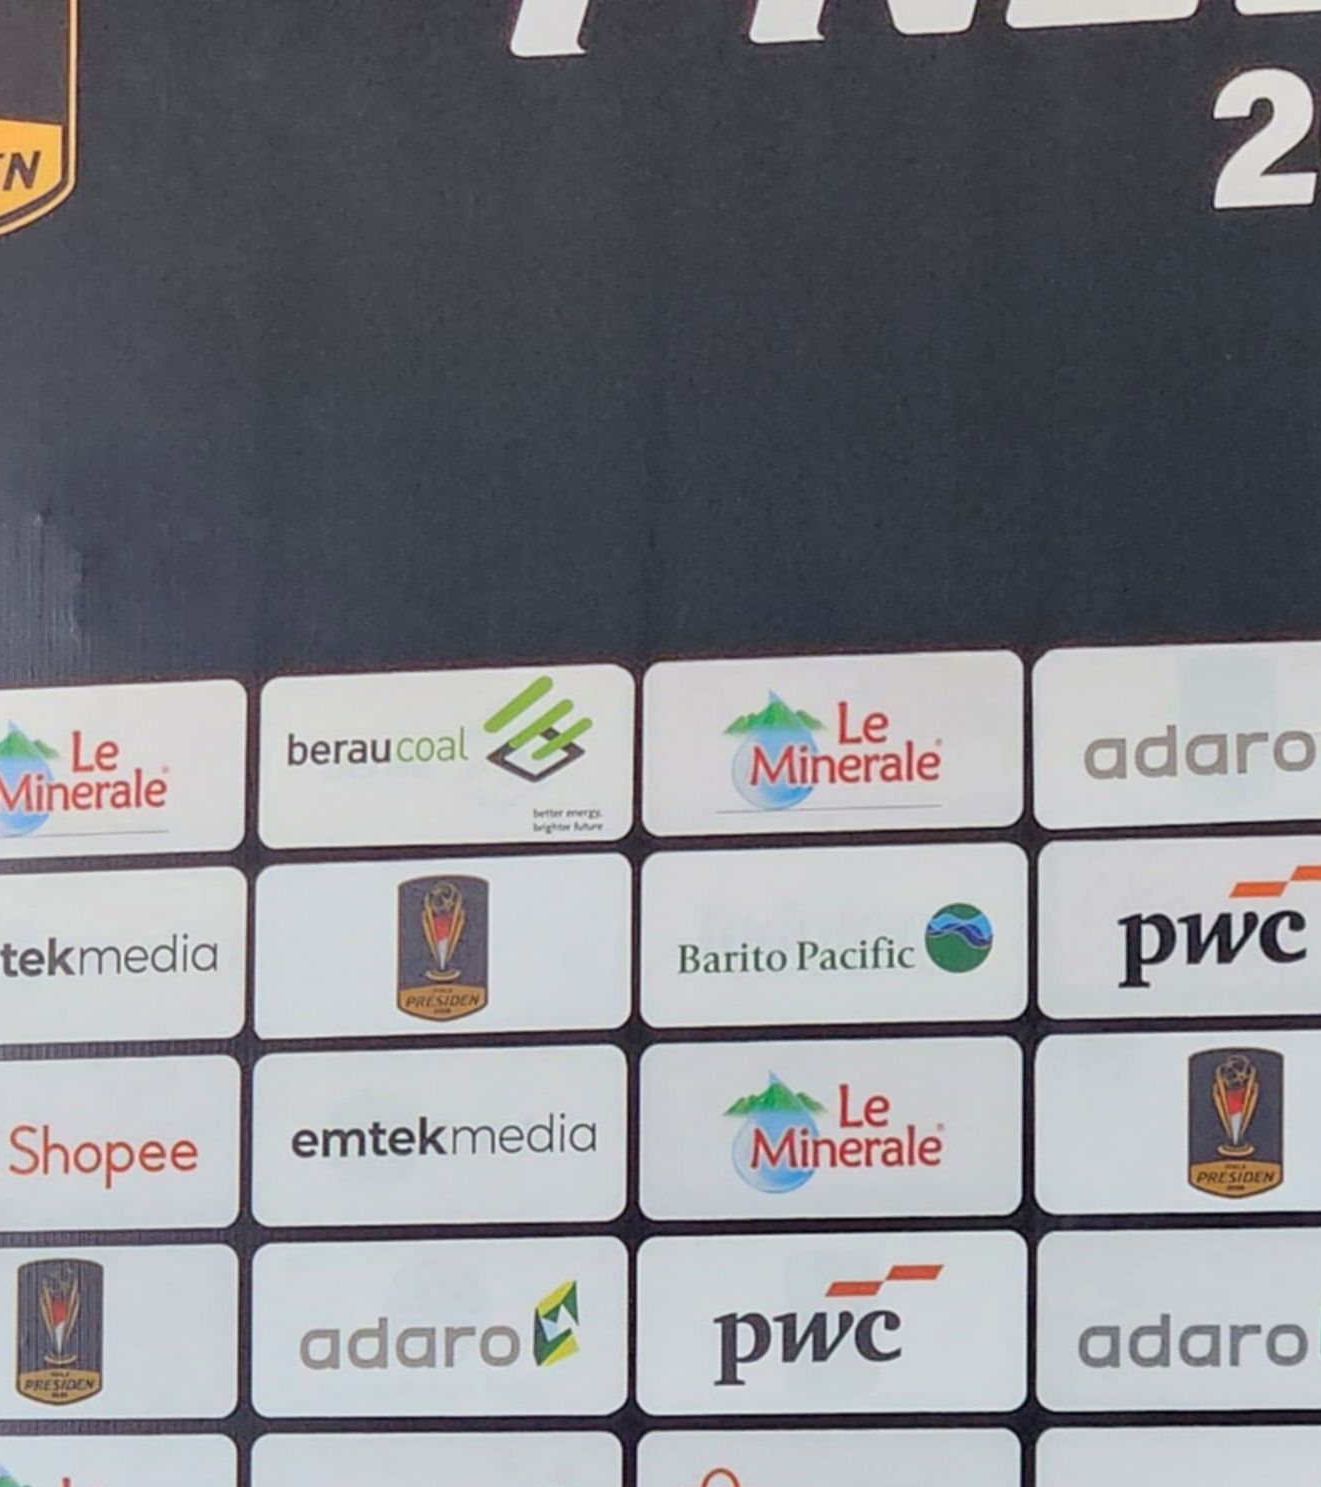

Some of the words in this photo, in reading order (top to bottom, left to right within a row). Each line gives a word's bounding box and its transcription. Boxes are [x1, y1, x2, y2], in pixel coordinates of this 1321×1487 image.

[837, 701, 888, 745] Le
[71, 731, 119, 772] Le
[749, 740, 942, 788] Minerale
[1084, 725, 1316, 780] adaro
[678, 941, 788, 974] Barito
[797, 937, 916, 971] Pacific
[1118, 909, 1307, 988] pwc
[838, 1084, 890, 1128] Le
[9, 1126, 199, 1189] Shopee
[291, 1114, 598, 1159] emtekmedia
[750, 1125, 944, 1171] Minerale
[299, 1318, 521, 1371] adaro
[713, 1309, 903, 1386] pwc
[1078, 1314, 1308, 1369] adaro
